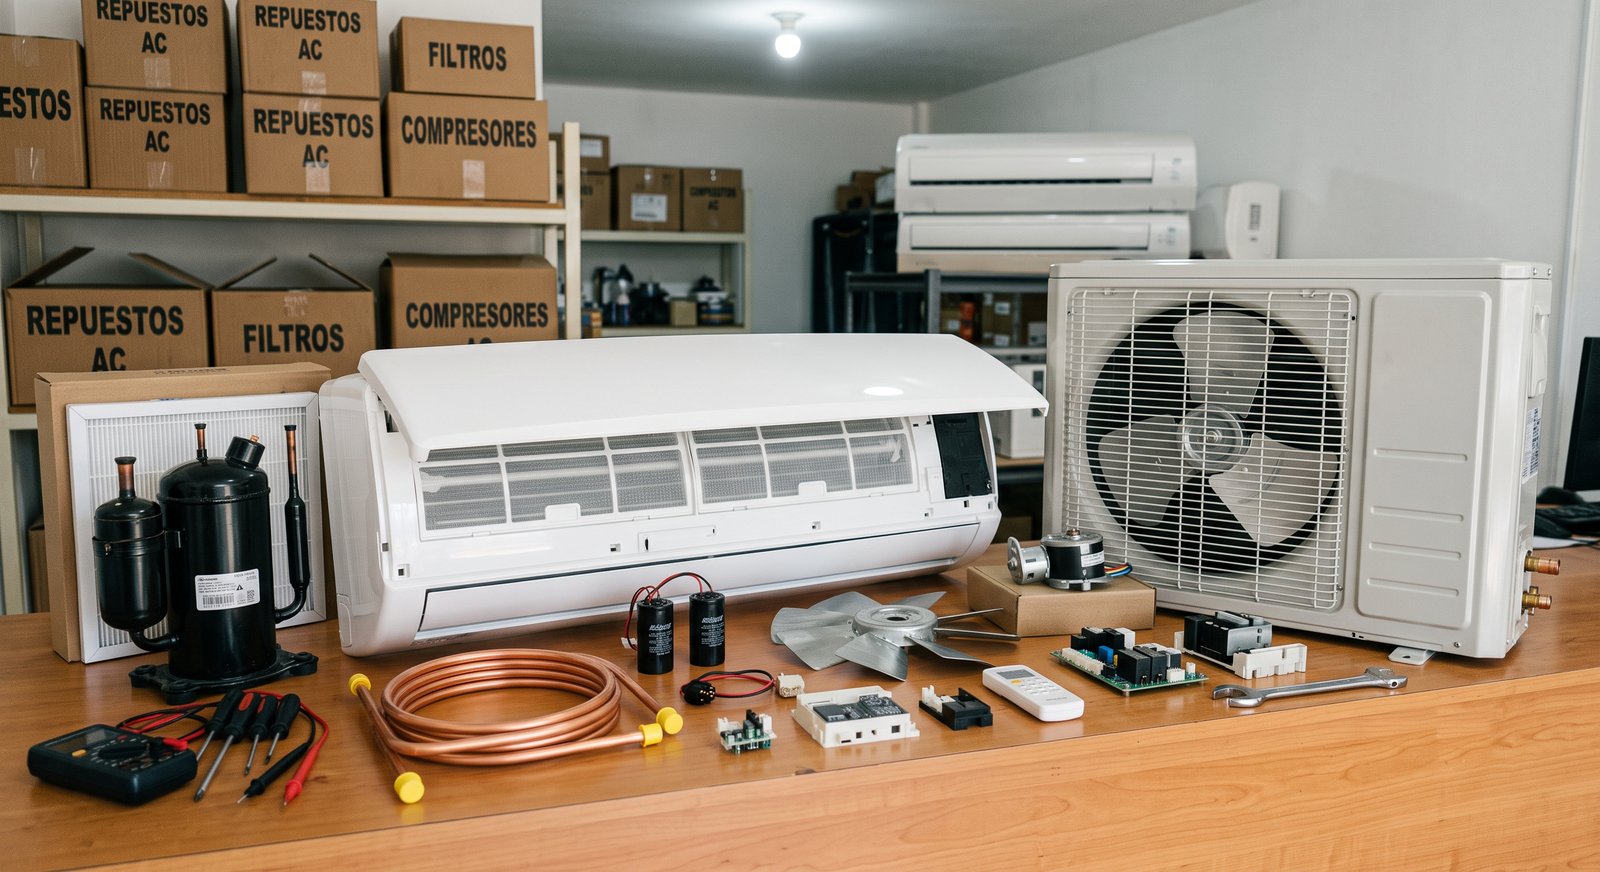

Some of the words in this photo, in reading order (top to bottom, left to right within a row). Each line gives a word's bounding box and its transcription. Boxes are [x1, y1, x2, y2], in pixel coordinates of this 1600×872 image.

[97, 0, 208, 27] REPUESTOS
[255, 5, 361, 33] REPUESTOS
[141, 31, 167, 54] AC
[298, 38, 322, 60] AC
[428, 41, 507, 71] FILTROS
[0, 86, 72, 121] ESTOS
[100, 98, 210, 125] REPUESTOS
[253, 108, 374, 138] REPUESTOS
[401, 115, 537, 148] COMPRESORES
[145, 130, 170, 152] AC
[302, 144, 329, 168] AC
[26, 305, 184, 336] REPUESTOS
[406, 302, 549, 328] COMPRESORES
[243, 323, 345, 353] FILTROS
[91, 347, 126, 372] AC
